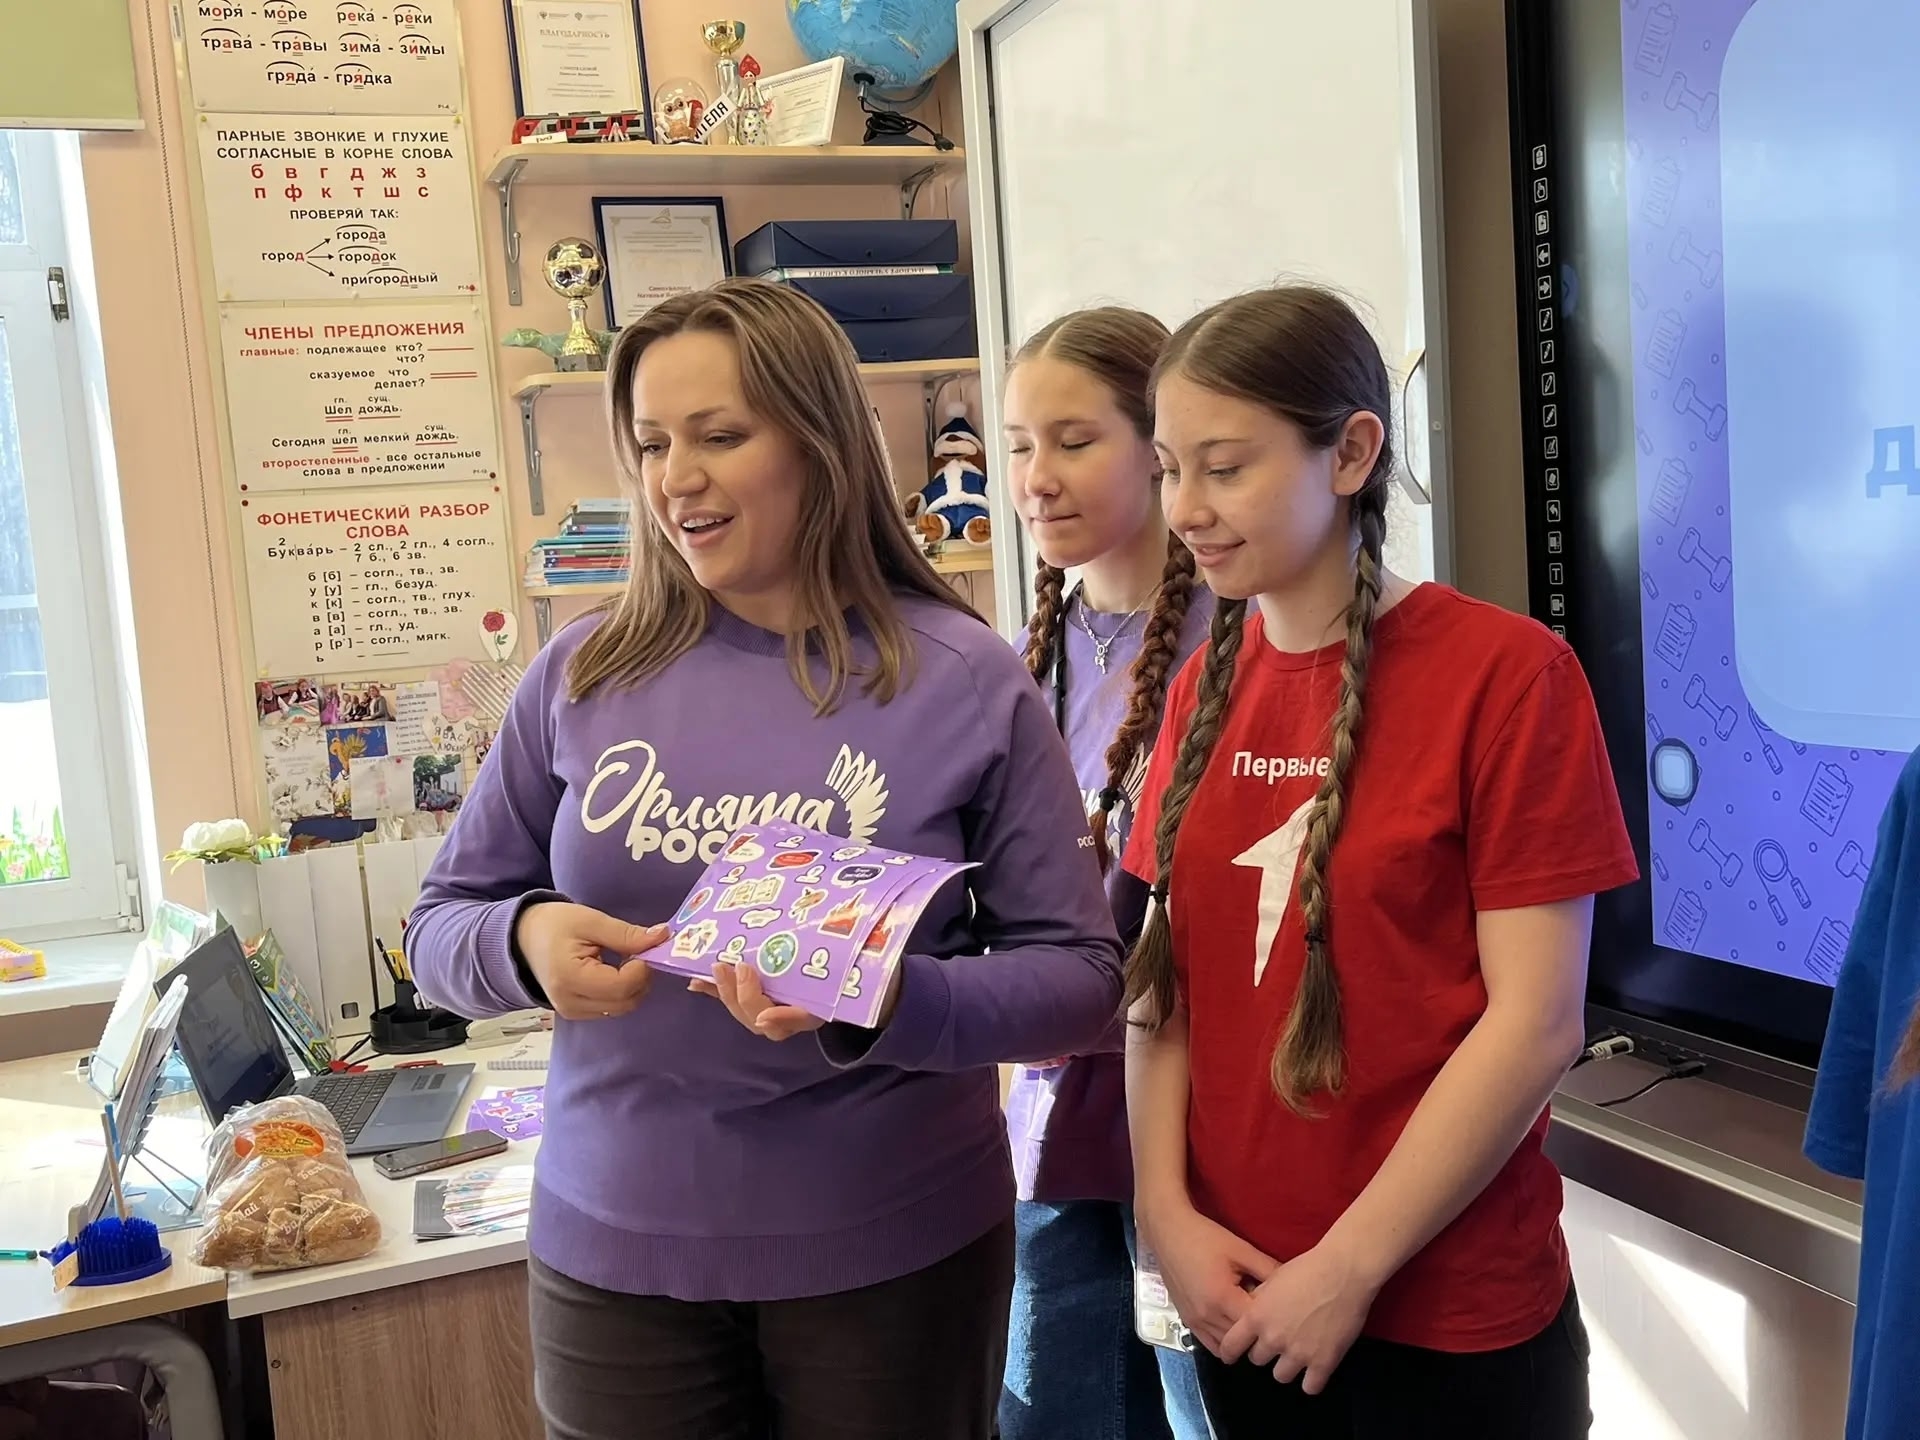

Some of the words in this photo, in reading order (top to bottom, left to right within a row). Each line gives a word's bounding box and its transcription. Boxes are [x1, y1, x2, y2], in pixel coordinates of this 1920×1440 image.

[217, 130, 286, 142] ПАРНЫЕ
[294, 131, 366, 142] ЗВОНКИЕ
[374, 131, 384, 142] И
[392, 131, 449, 143] ГЛУХИЕ
[217, 147, 316, 159] СОГЛАСНЫЕ
[325, 148, 335, 159] В
[343, 148, 394, 159] КОРНЕ
[402, 147, 453, 159] СЛОВА
[251, 163, 264, 179] б
[286, 167, 297, 179] в
[320, 167, 328, 178] г
[350, 167, 364, 181] д
[381, 167, 397, 179] ж
[416, 167, 426, 178] з
[254, 187, 266, 199] п
[285, 184, 302, 202] ф
[321, 187, 332, 198] к
[353, 187, 364, 198] т
[384, 187, 400, 198] ш
[418, 186, 429, 198] с
[290, 208, 364, 220] ПРОВЕРЯЙ
[370, 209, 399, 220] ТАК:
[336, 230, 386, 242] города
[261, 252, 305, 263] город
[339, 252, 397, 264] городок
[341, 272, 438, 286] пригородный
[245, 326, 314, 340] ЧЛЕНЫ
[324, 322, 465, 340] ПРЕДЛОЖЕНИЯ
[240, 347, 299, 357] главные:
[307, 344, 386, 356] подлежащее
[395, 342, 423, 352] кто?
[396, 354, 425, 364] что?
[310, 369, 375, 381] сказуемое
[388, 368, 409, 377] что
[374, 378, 425, 391] делает?
[368, 395, 391, 405] сущ.
[325, 405, 353, 415] Шел
[358, 404, 402, 416] дождь.
[272, 436, 325, 448] Сегодня
[332, 435, 357, 445] шел
[364, 432, 410, 443] мелкий
[415, 430, 459, 443] дождь.
[262, 454, 370, 468] второстепенные
[387, 453, 408, 463] все
[414, 449, 482, 462] остальные
[303, 466, 341, 477] слова
[347, 466, 355, 475] в
[361, 461, 446, 475] предложении
[257, 504, 411, 526] ФОНЕТИЧЕСКИЙ
[419, 502, 490, 518] РАЗБОР
[346, 524, 410, 539] СЛОВА
[278, 537, 286, 546] 2
[354, 543, 361, 552] 2
[368, 542, 393, 552] сл.,
[400, 540, 407, 550] 2
[414, 540, 437, 550] гл.,
[443, 538, 450, 548] 4
[456, 537, 494, 548] согл.,
[355, 554, 362, 563] 7
[370, 552, 386, 563] б.,
[393, 551, 400, 561] 6
[407, 551, 426, 561] зв.
[308, 570, 317, 582] б
[323, 570, 342, 583] [б]
[364, 567, 403, 579] согл.,
[410, 567, 433, 577] тв.,
[439, 565, 459, 575] зв.
[309, 586, 317, 597] у
[324, 585, 342, 598] [у]
[366, 582, 388, 592] гл.,
[395, 578, 438, 590] безуд.
[311, 600, 318, 609] к
[326, 598, 343, 611] [к]
[367, 594, 406, 606] согл.,
[412, 593, 436, 603] тв.,
[442, 590, 476, 601] глух.
[312, 613, 320, 622] в
[327, 611, 345, 624] [в]
[368, 608, 407, 619] согл.,
[414, 606, 437, 617] тв.,
[443, 604, 463, 614] зв.
[313, 627, 321, 635] а
[328, 625, 346, 637] [а]
[369, 622, 392, 633] гл.,
[399, 620, 419, 632] уд.
[315, 640, 323, 651] р
[370, 634, 410, 646] согл.,
[416, 632, 451, 643] мягк.
[1232, 751, 1331, 785] Первые
[581, 739, 836, 849] Орлята
[629, 826, 728, 865] РОС
